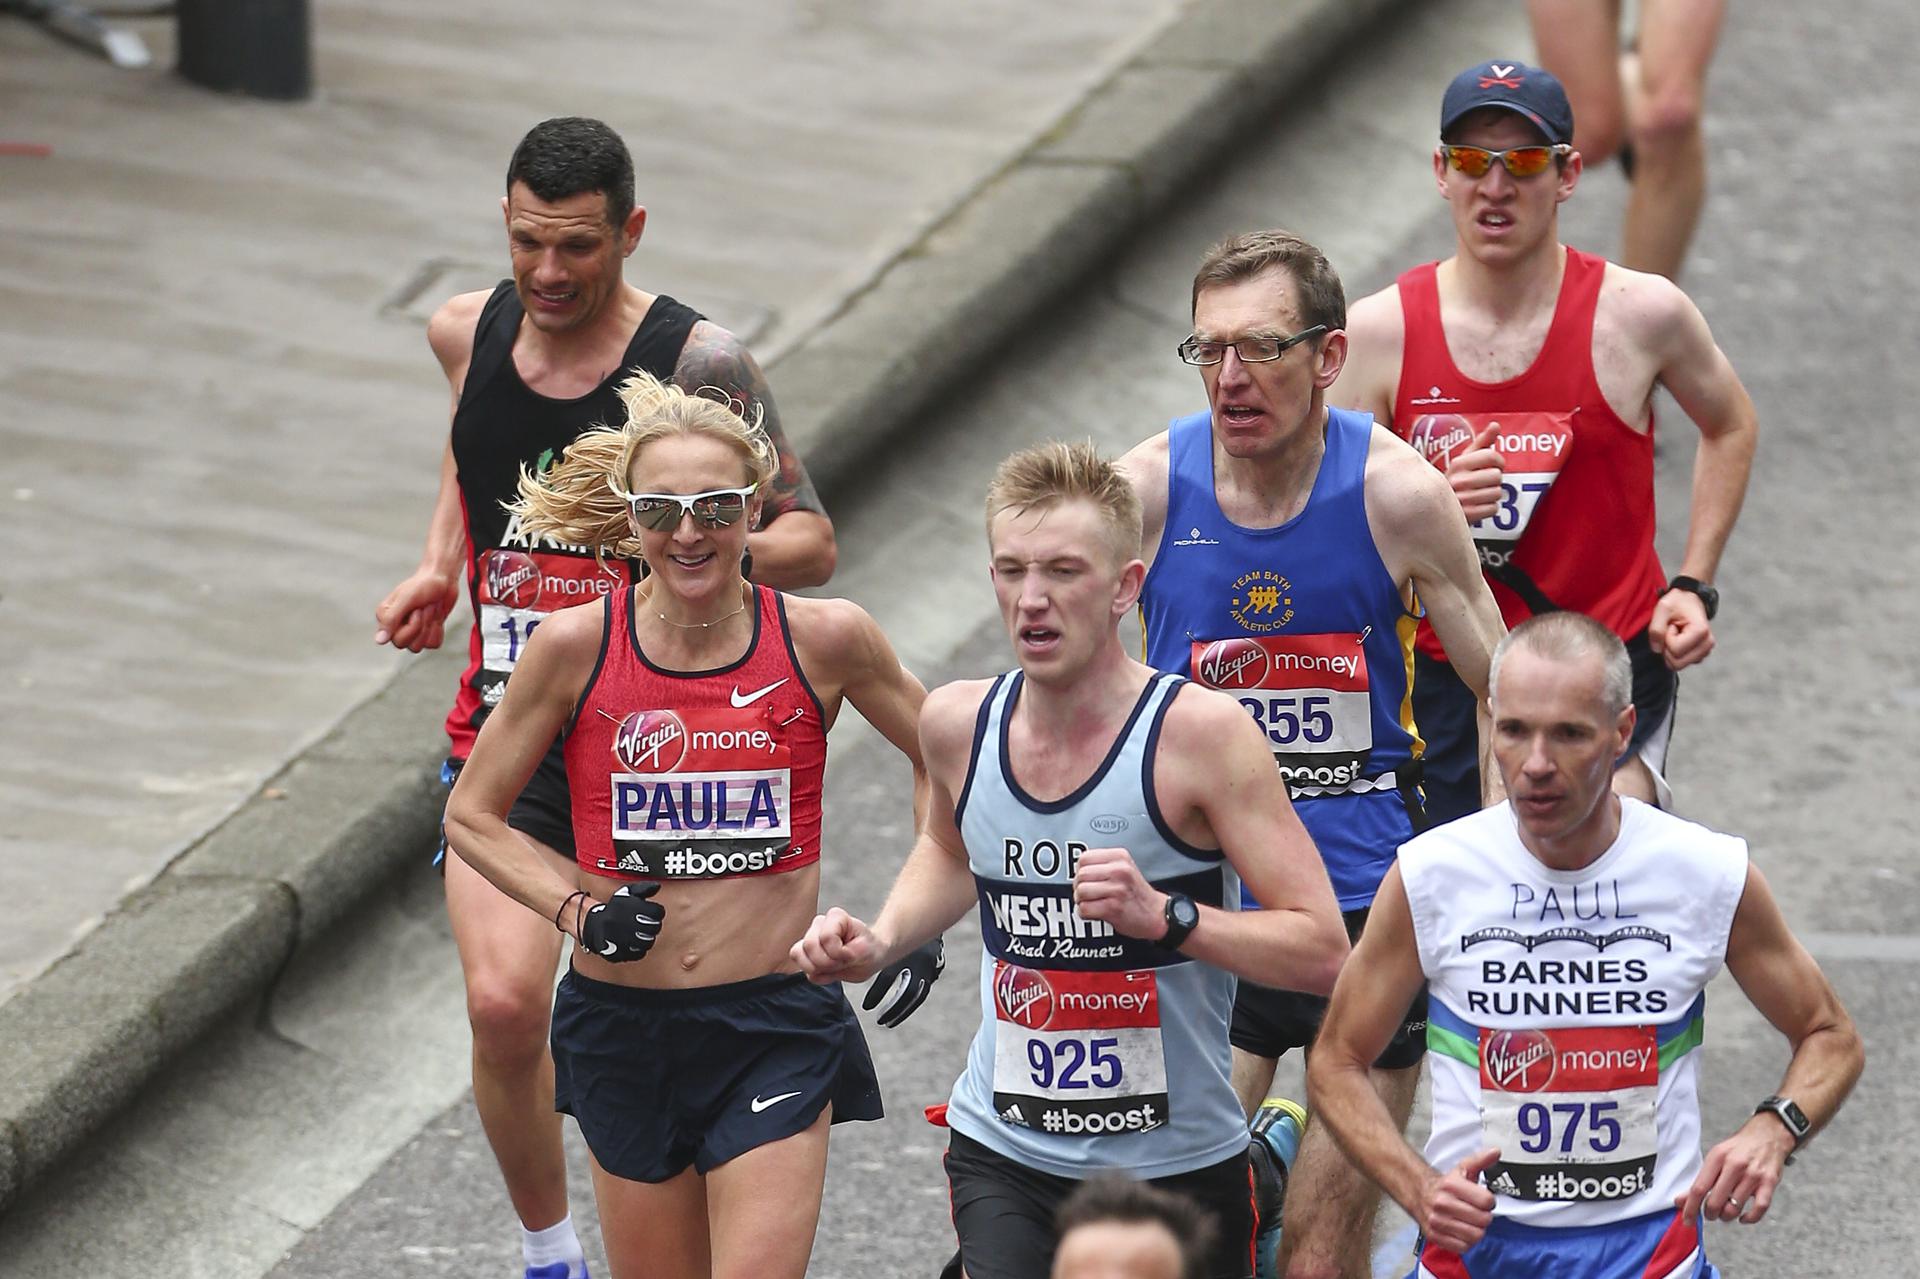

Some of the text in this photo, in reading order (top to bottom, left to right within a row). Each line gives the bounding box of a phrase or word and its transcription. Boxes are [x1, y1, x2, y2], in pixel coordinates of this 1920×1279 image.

[1414, 417, 1471, 468] Virgin
[1471, 483, 1552, 531] 37
[489, 554, 537, 604] Virgin
[1231, 571, 1292, 591] TEAM BATH
[1230, 609, 1295, 632] ATHLETIC CLUB
[1205, 642, 1359, 684] Virgin money
[617, 714, 777, 769] Virgin money
[618, 778, 780, 830] PAULA
[1094, 820, 1128, 832] wasp
[664, 846, 777, 875] #boost
[1511, 879, 1639, 922] PAUL
[1006, 934, 1124, 959] Road Runners
[1482, 959, 1648, 985] BARNES
[1000, 968, 1150, 1024] Virgin money
[1467, 990, 1668, 1016] RUNNERS
[1027, 1038, 1123, 1090] 925
[1490, 1032, 1652, 1088] Virgin money
[1042, 1104, 1156, 1133] #boost
[1517, 1101, 1622, 1154] 975
[1535, 1166, 1646, 1199] #boost
